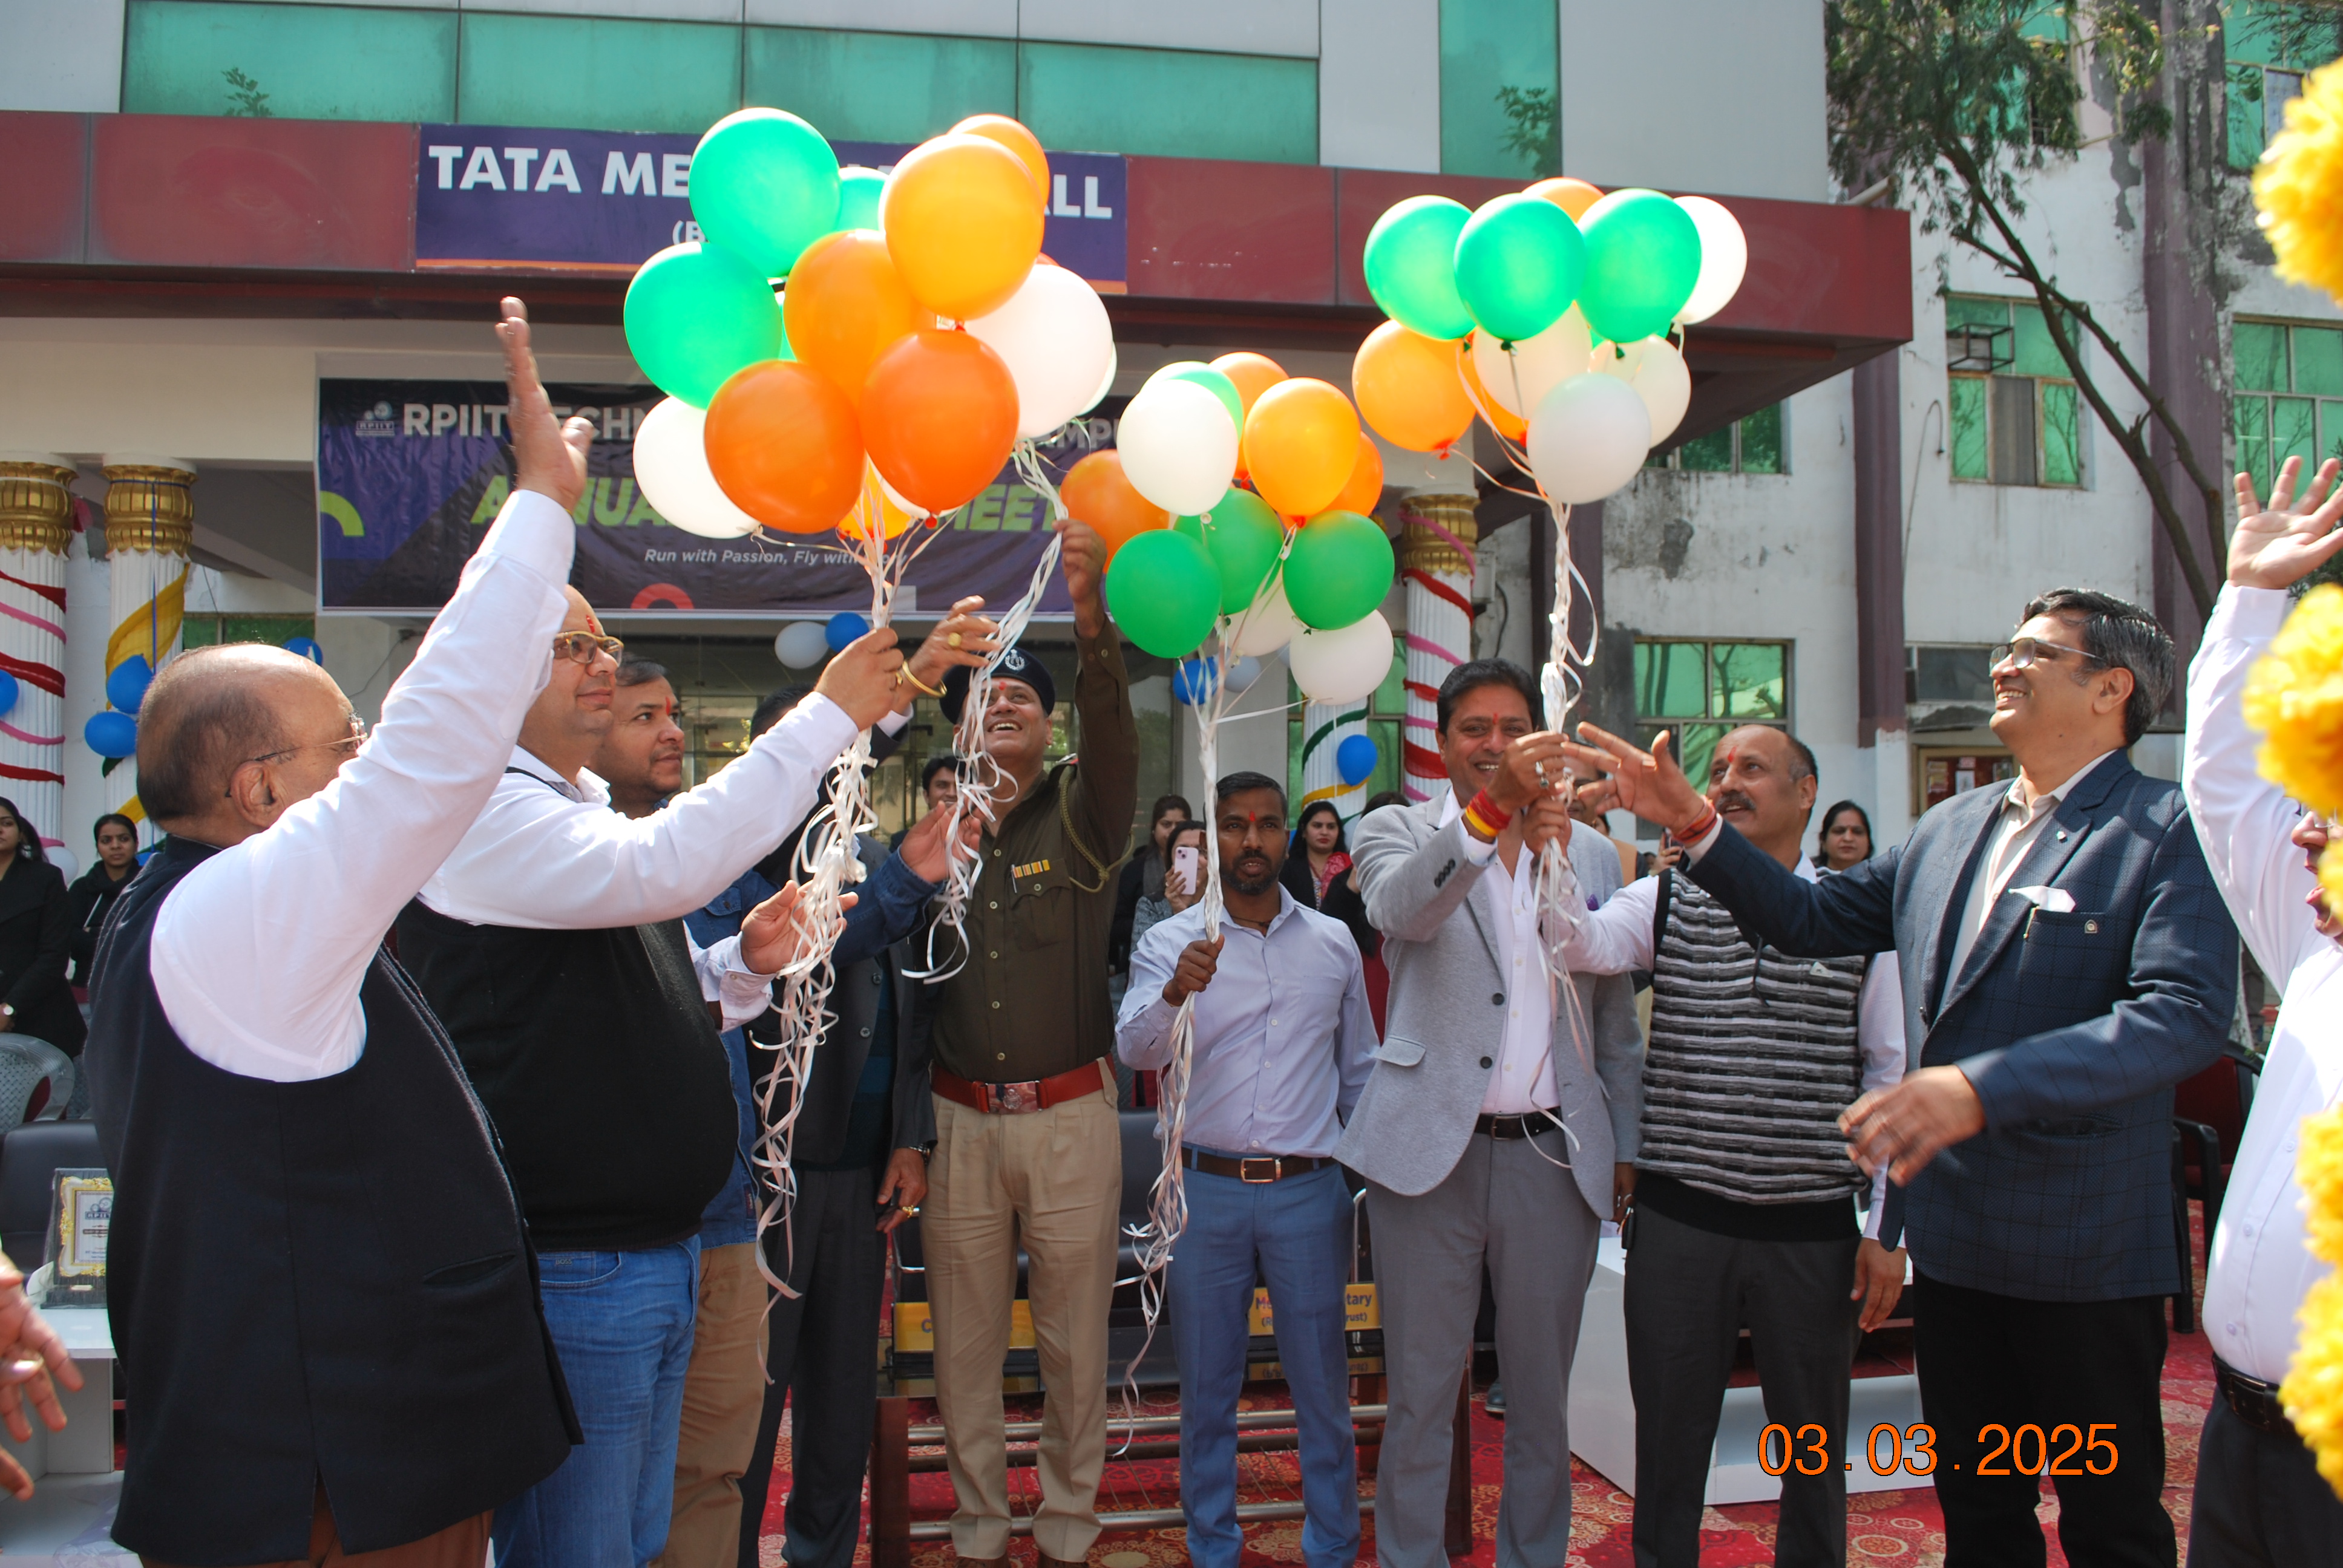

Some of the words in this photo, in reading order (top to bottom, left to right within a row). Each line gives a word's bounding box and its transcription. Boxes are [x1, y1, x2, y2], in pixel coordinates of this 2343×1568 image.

[428, 145, 582, 193] TATA
[601, 151, 692, 197] ME
[1044, 174, 1112, 219] LL
[672, 220, 706, 245] (B
[644, 549, 676, 562] Run
[682, 549, 717, 563] with
[722, 549, 787, 565] Passion,
[793, 550, 818, 566] Fly
[1346, 1293, 1372, 1307] tary
